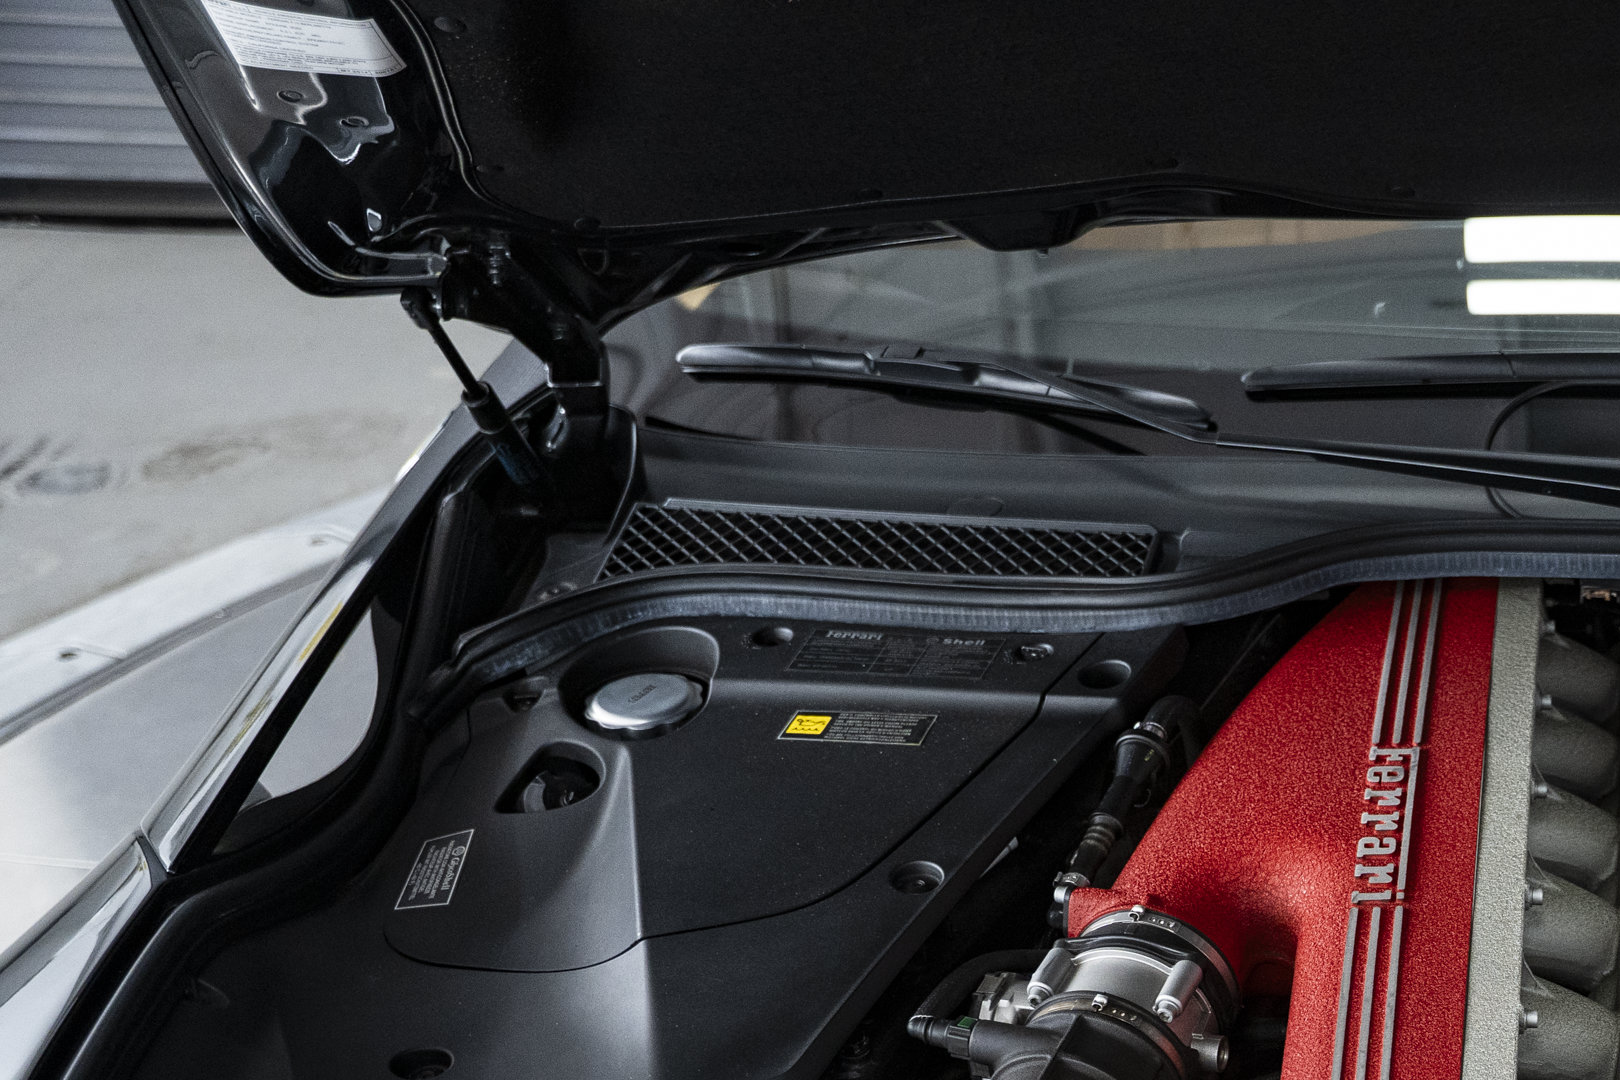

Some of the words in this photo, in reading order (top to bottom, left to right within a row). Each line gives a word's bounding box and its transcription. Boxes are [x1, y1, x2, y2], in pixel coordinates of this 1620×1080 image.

[825, 630, 884, 641] Ferrari
[942, 637, 986, 646] Shell
[1350, 745, 1422, 905] Ferrari
